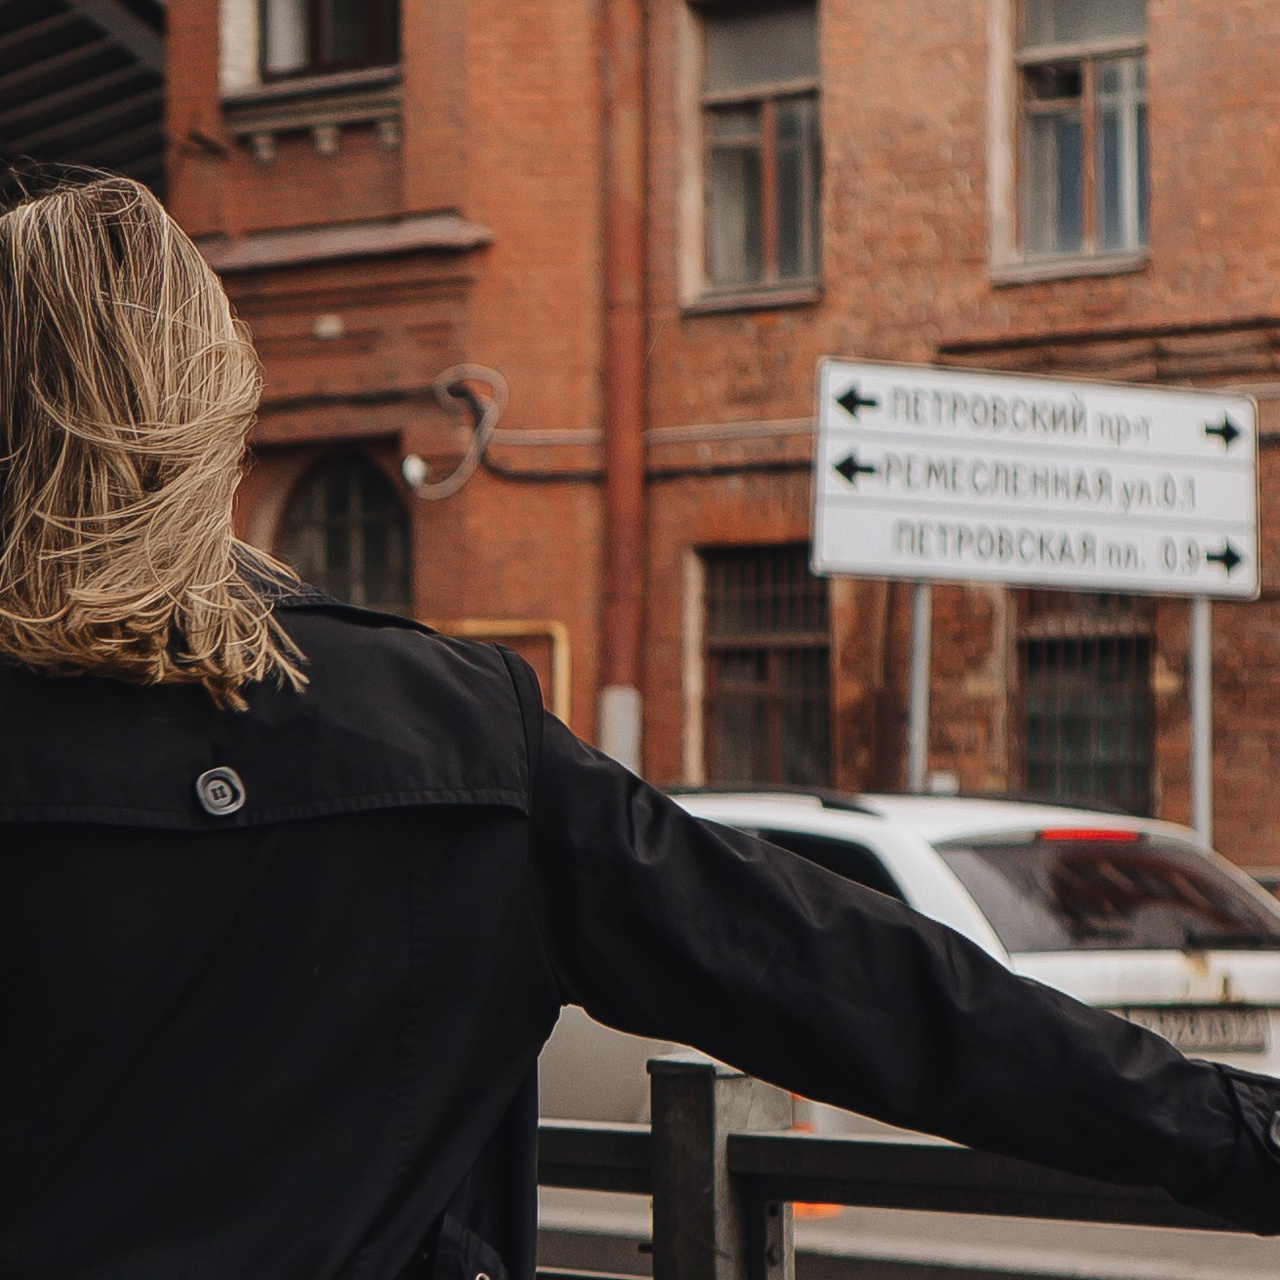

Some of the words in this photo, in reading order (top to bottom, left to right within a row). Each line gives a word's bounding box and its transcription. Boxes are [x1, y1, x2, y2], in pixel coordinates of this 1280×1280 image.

[890, 385, 1088, 435] ПЕТРОВСКИЙ
[1096, 411, 1152, 447] пр-т
[883, 452, 1112, 504] РЕМЕСЛЕННАЯ
[893, 520, 1096, 566] ПЕТРОВСКАЯ
